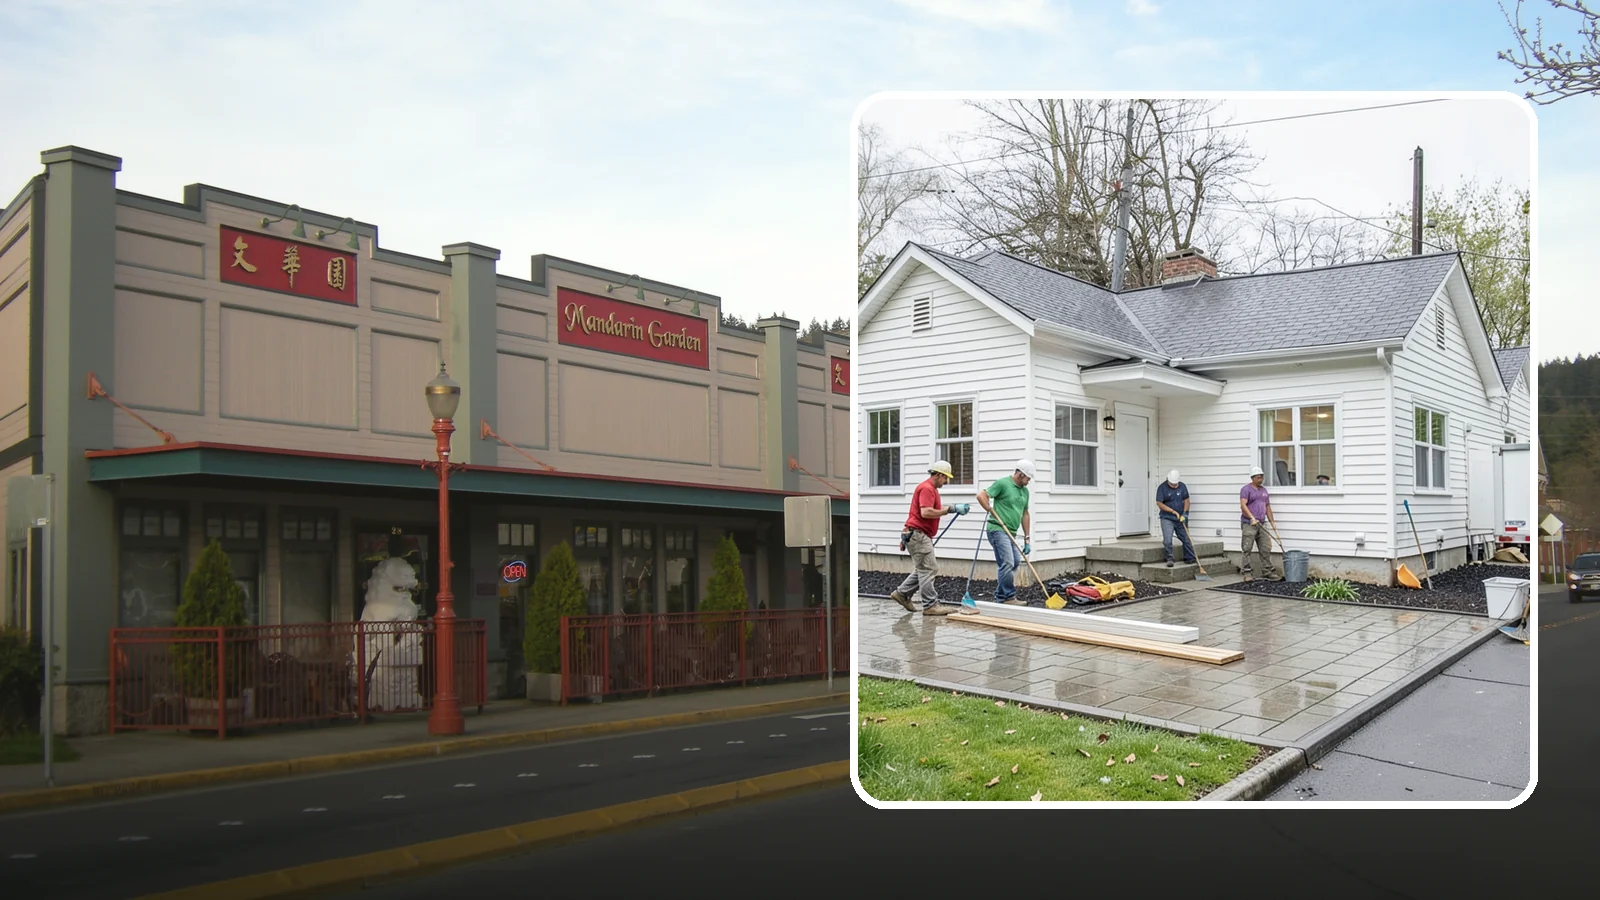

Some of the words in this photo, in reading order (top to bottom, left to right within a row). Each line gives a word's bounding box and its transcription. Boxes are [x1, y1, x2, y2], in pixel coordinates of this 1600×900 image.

[231, 235, 346, 290] 文華園
[564, 302, 643, 340] Mandarin
[648, 320, 701, 351] Garden
[835, 363, 846, 386] 文
[503, 565, 526, 578] OPEN
